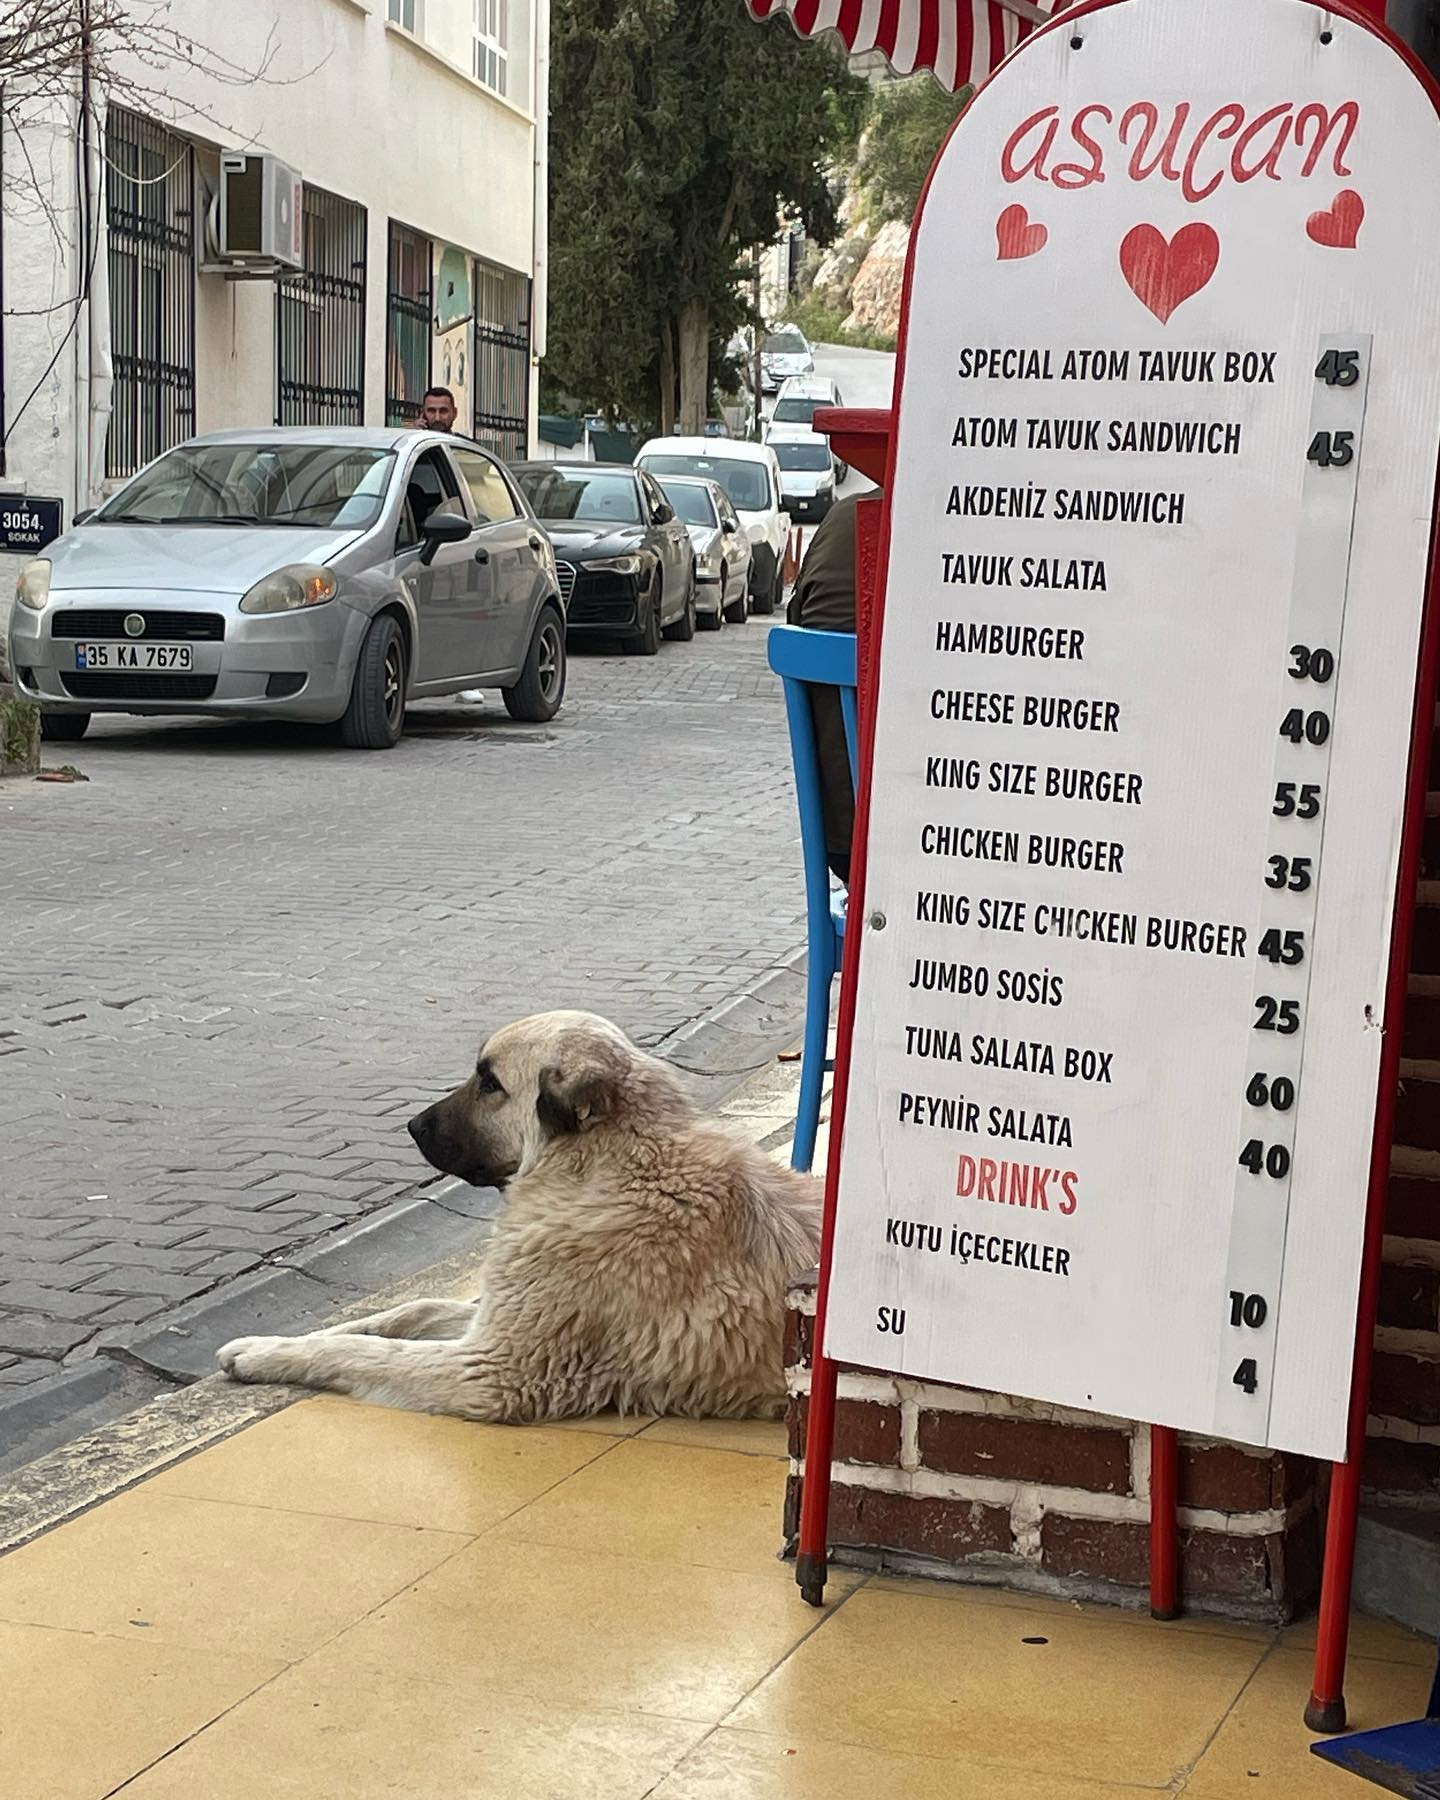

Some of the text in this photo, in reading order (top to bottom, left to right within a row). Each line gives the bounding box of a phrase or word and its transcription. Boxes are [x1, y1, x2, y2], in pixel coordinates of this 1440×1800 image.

[958, 347, 1278, 383] SPECIAL ATOM TAVUK BOX
[1314, 350, 1360, 387] 45
[951, 416, 1241, 455] ATOM TAVUK SANDWICH
[1306, 430, 1355, 468] 45
[3, 511, 44, 531] 3054.
[945, 480, 1185, 524] AKDENİZ SANDWICH
[7, 531, 41, 543] SOKAK
[941, 553, 1107, 592] TAVUK SALATA
[88, 646, 190, 668] 35 KA 7679
[935, 621, 1085, 660] HAMBURGER
[1287, 644, 1334, 684] 30
[931, 689, 1120, 733] CHEESE BURGER
[1279, 708, 1331, 746] 40
[926, 756, 1143, 805] KING SIZE BURGER
[1271, 782, 1321, 820] 55
[921, 824, 1124, 874] CHICKEN BURGER
[1264, 854, 1312, 893] 35
[916, 891, 1247, 958] KING SIZE CHICKEN BURGER
[1257, 928, 1305, 966] 45
[908, 959, 1064, 1007] JUMBO SOSİS
[1252, 995, 1300, 1035] 25
[905, 1025, 1114, 1084] TUNA SALATA BOX
[1245, 1072, 1295, 1112] 60
[899, 1092, 1073, 1148] PEYNİR SALATA
[1238, 1138, 1291, 1180] 40
[956, 1154, 1079, 1215] DRINK'S
[886, 1218, 1070, 1277] KUTU İÇECEKLER
[876, 1306, 906, 1335] SU
[1229, 1290, 1268, 1329] 10
[1232, 1357, 1258, 1395] 4
